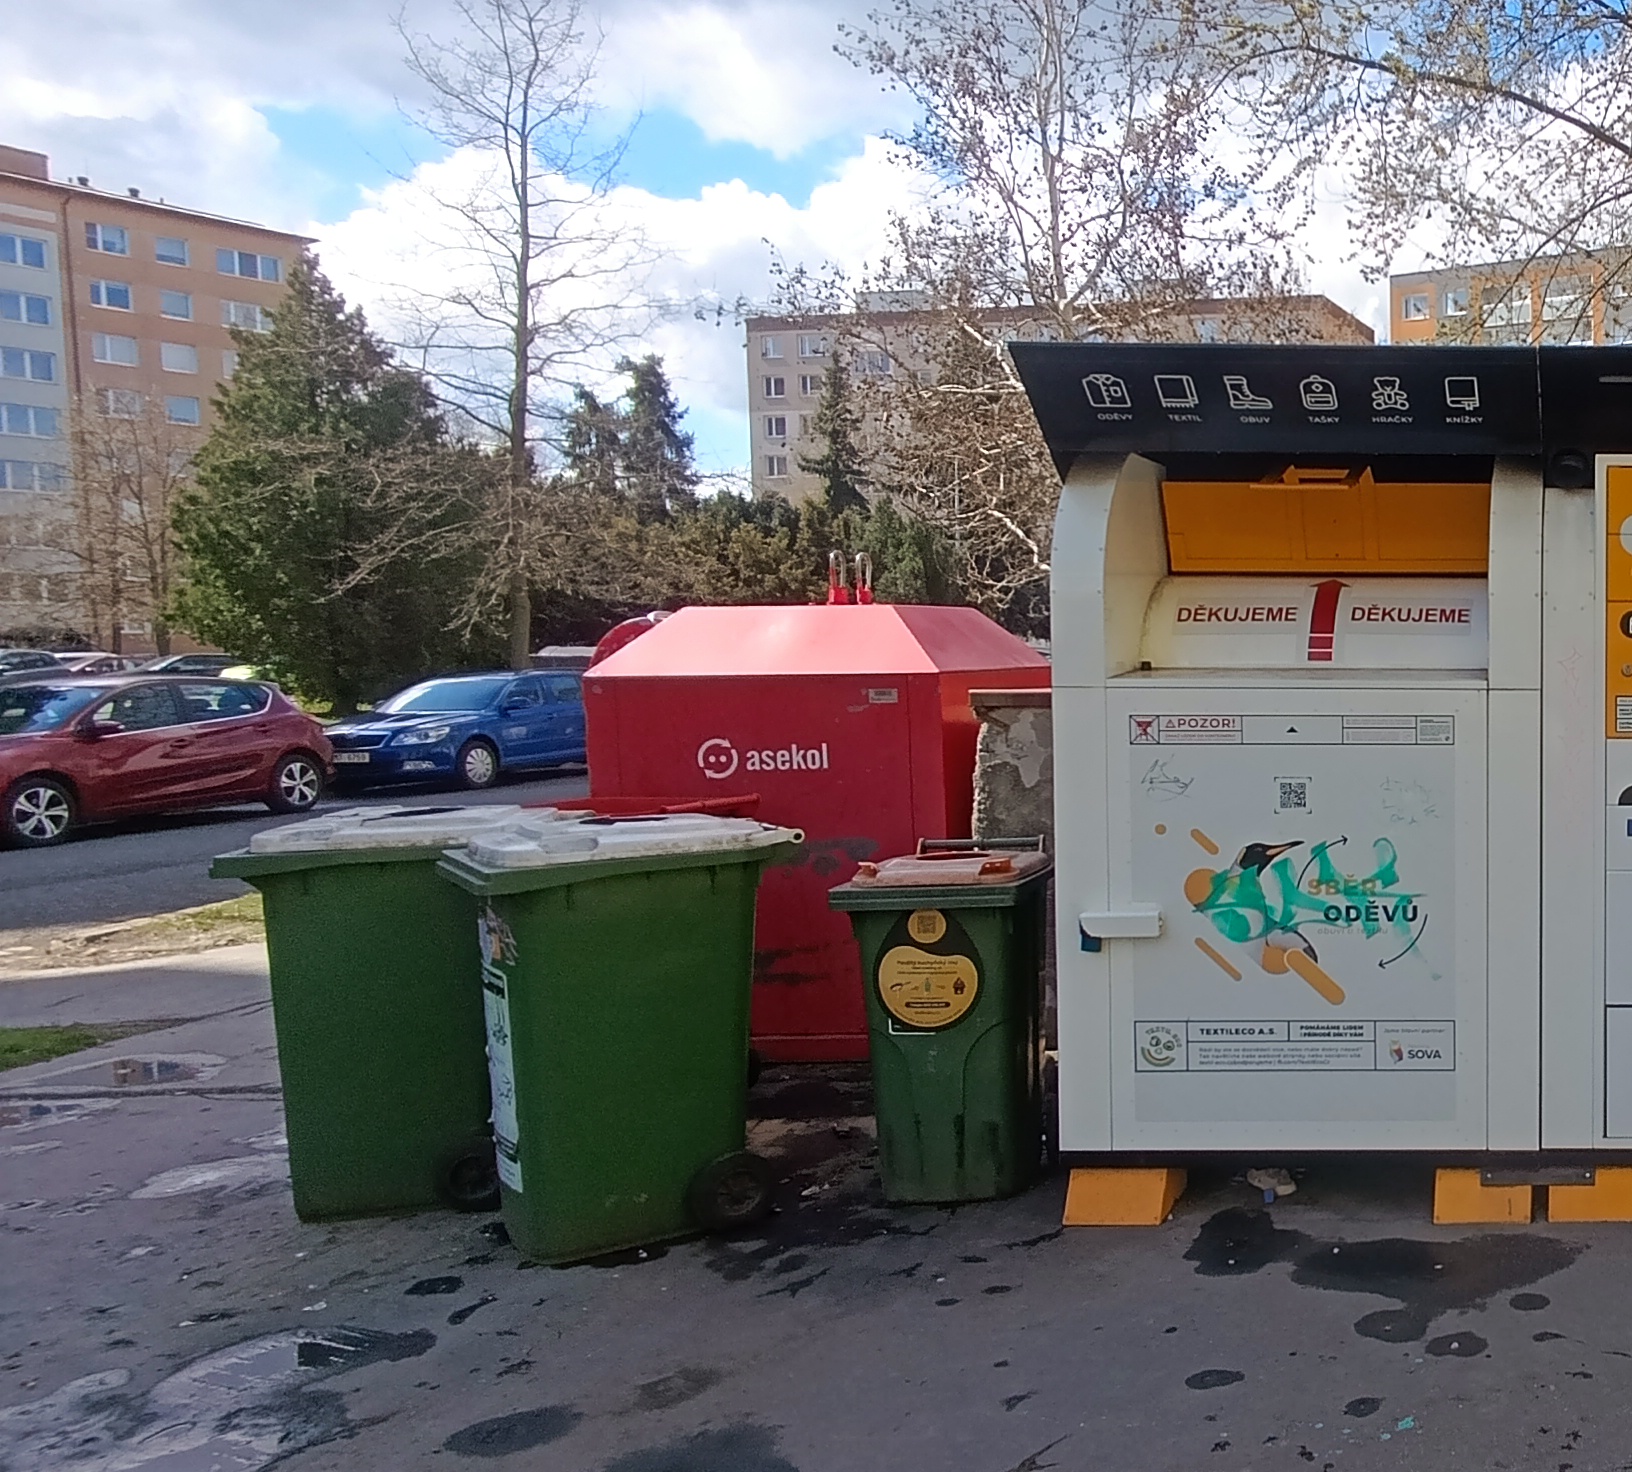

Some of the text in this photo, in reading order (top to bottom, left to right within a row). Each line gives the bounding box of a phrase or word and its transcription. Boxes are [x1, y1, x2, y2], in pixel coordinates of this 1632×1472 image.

[1097, 412, 1133, 421] ODĚVY
[1167, 413, 1203, 422] TEXTIL
[1239, 415, 1271, 424] OBUV
[1307, 415, 1340, 424] TAŠKY
[1371, 415, 1414, 424] HRAČKY
[1445, 415, 1484, 424] KNÍŽKY
[1176, 603, 1298, 623] DĚKUJEME
[1351, 603, 1471, 624] DĚKUJEME
[1177, 717, 1236, 729] POZOR!
[745, 742, 829, 771] asekol
[1307, 873, 1377, 896] SBĚR
[1323, 898, 1418, 922] ODĚVŮ
[1199, 1027, 1278, 1036] TEXTILECO A.S.
[1407, 1049, 1442, 1059] SOVA
